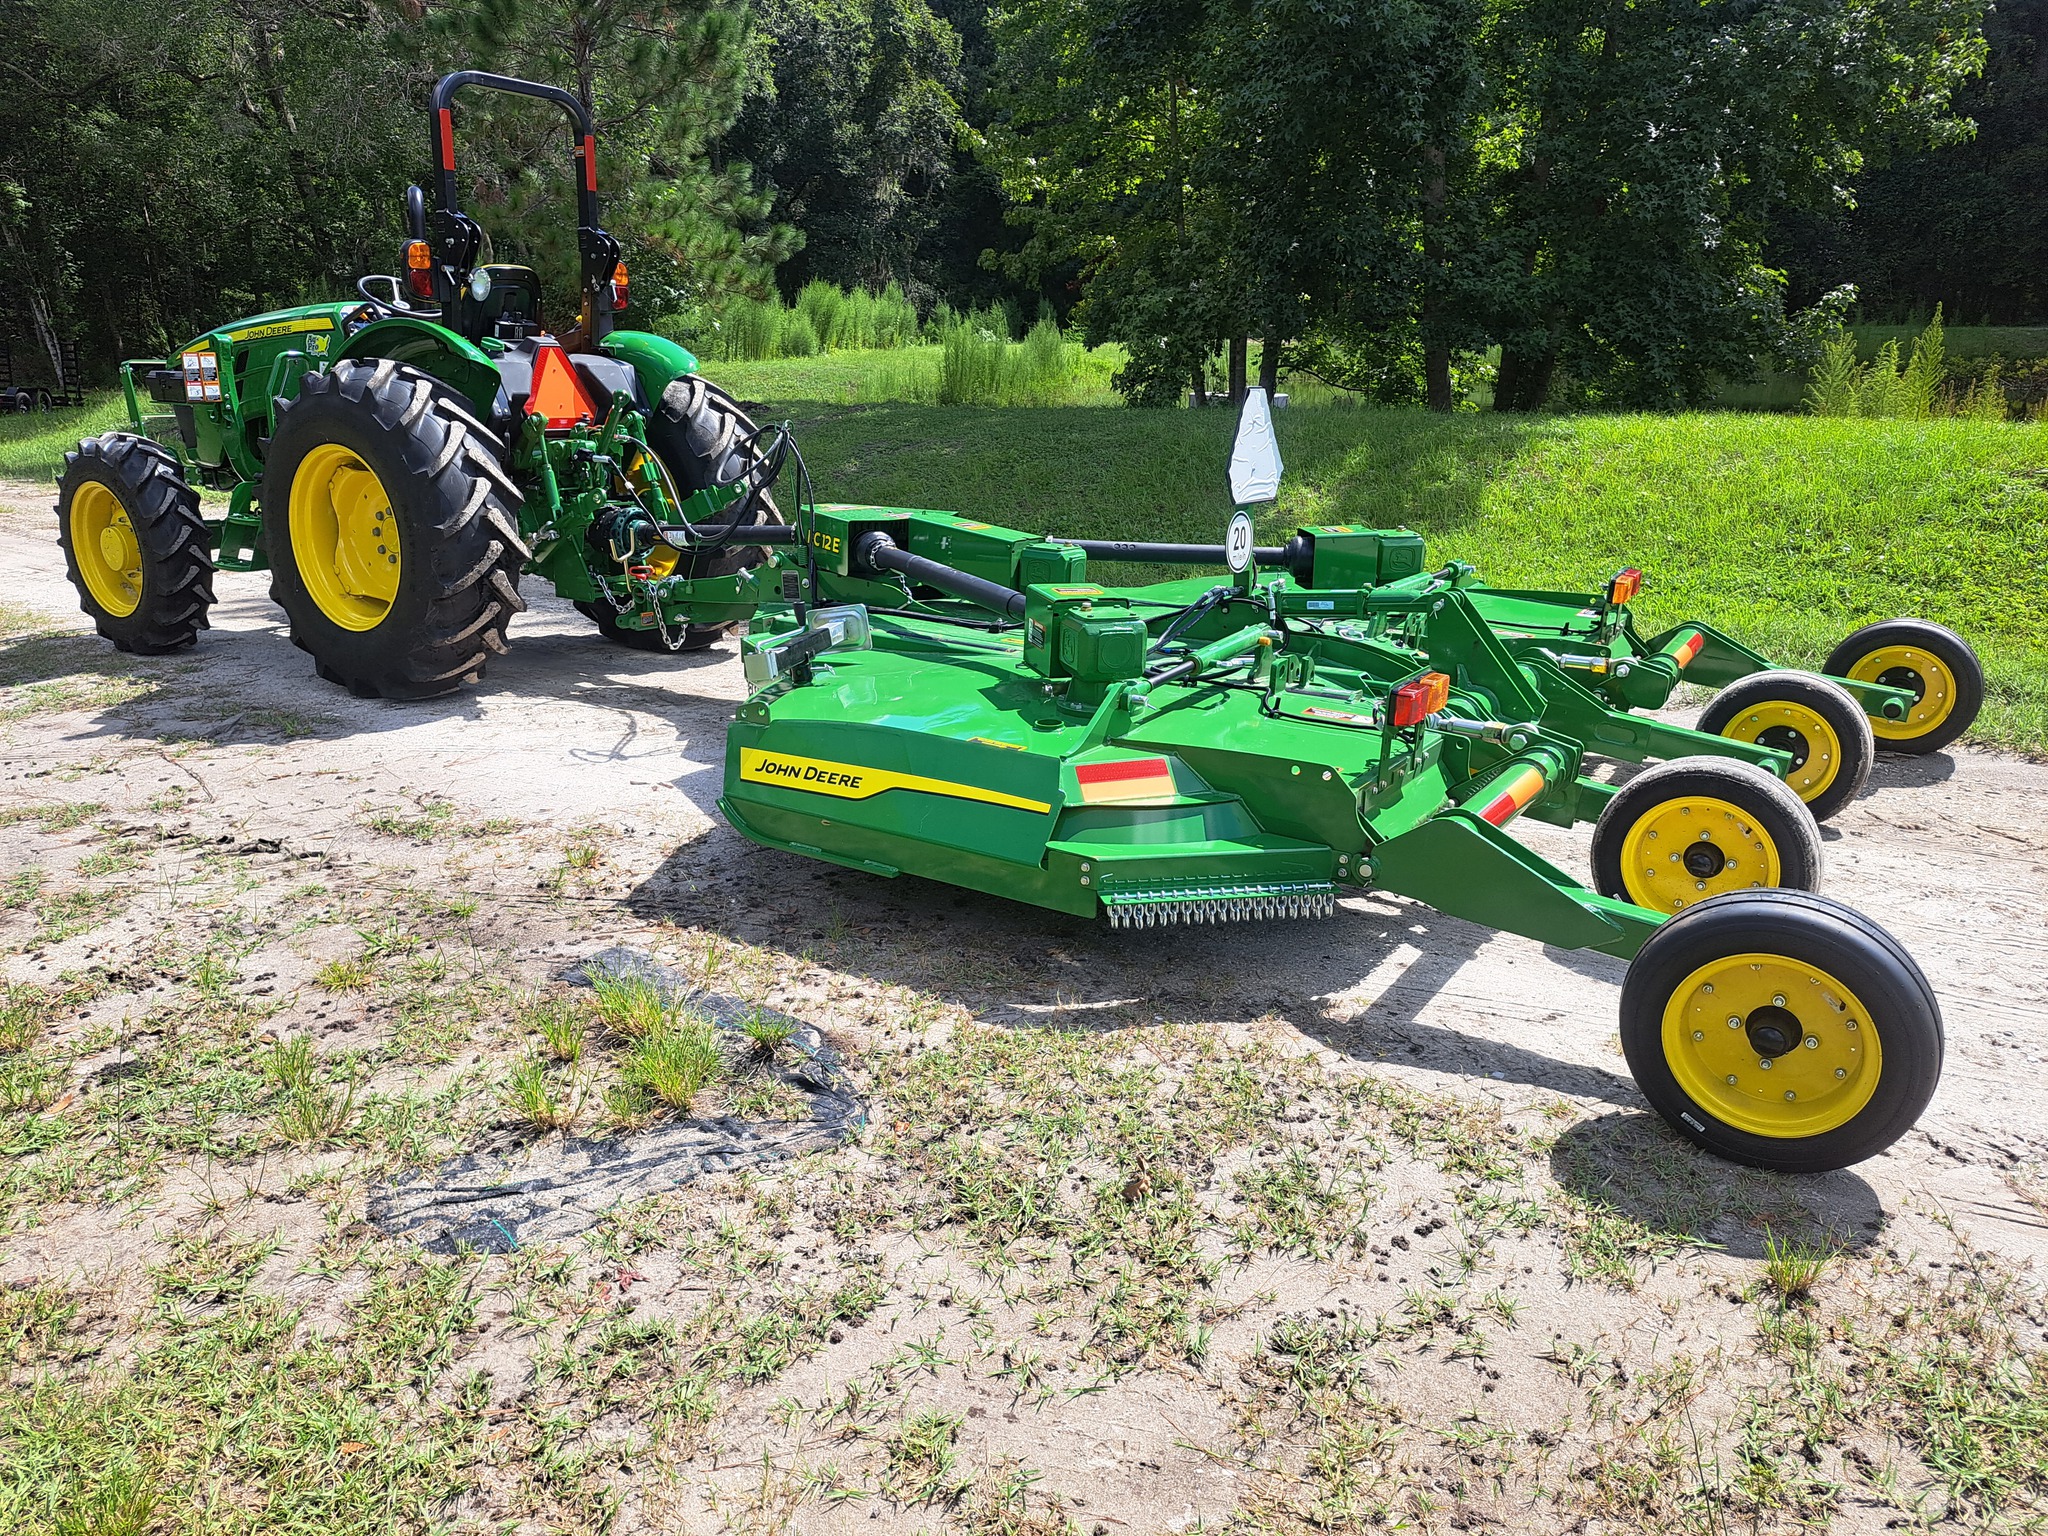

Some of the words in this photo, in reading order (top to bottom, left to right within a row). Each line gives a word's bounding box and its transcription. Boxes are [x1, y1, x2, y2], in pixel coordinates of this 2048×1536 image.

[245, 328, 265, 339] JOHN
[266, 325, 292, 336] DEERE
[1233, 525, 1247, 551] 20
[755, 759, 802, 778] JOHN
[803, 766, 863, 789] DEERE
